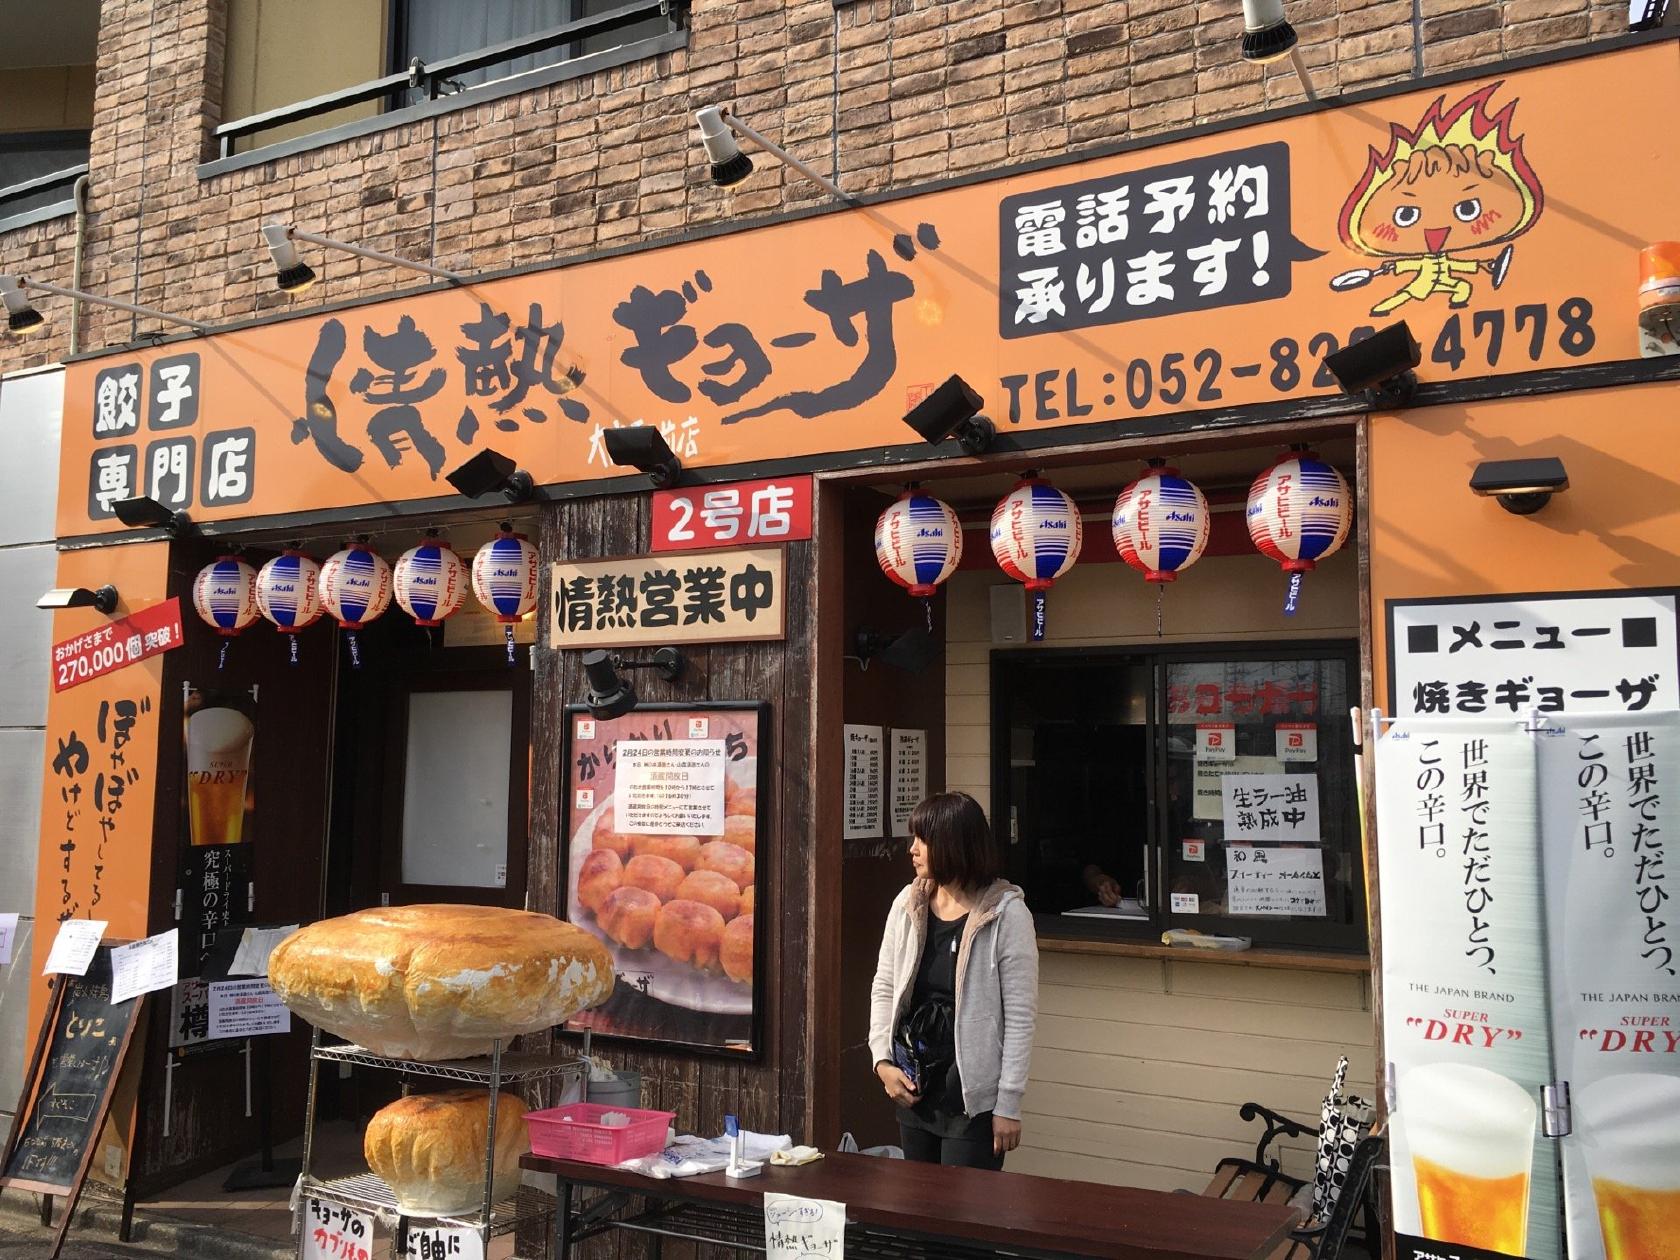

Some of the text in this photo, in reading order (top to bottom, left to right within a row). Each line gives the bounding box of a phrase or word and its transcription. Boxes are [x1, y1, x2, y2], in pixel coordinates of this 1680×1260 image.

[1014, 164, 1269, 259] 電話予約
[1014, 230, 1270, 325] 承ります！
[96, 365, 192, 432] 餃子
[96, 437, 249, 512] 専門店
[668, 485, 793, 542] 2号店
[1138, 490, 1153, 551] アサヒビール
[1166, 511, 1195, 522] Asahi
[1278, 475, 1293, 538] アサヒビール
[1309, 496, 1339, 508] Asahi
[890, 511, 905, 567] アサヒビール
[917, 529, 943, 537] Asahi
[1011, 500, 1029, 560] アサヒビール
[1039, 520, 1067, 529] Asahi
[213, 587, 236, 595] Asahi
[271, 584, 294, 592] Asahi
[346, 577, 370, 588] Asahi
[413, 577, 436, 585] Asahi
[493, 569, 517, 577] Asahi
[556, 563, 773, 633] 情熱営業中
[1034, 598, 1044, 637] アサヒビール
[55, 627, 113, 661] おかげさまで
[1413, 674, 1659, 714] 焼きギョーザ
[87, 695, 150, 919] ぼやぼやしてる
[1233, 784, 1307, 808] 生ラー油
[1416, 740, 1446, 858] この辛口。
[1578, 735, 1614, 858] この辛口。
[1460, 739, 1496, 975] 世界でただひとつ、
[1623, 731, 1676, 976] 世界でただひとつ、
[1409, 983, 1515, 1003] THE JAPAN BRAND
[1580, 993, 1604, 1002] THE
[1609, 993, 1648, 1002] JAPAN
[1443, 1008, 1489, 1023] SUPER
[1620, 1016, 1670, 1026] SUPER
